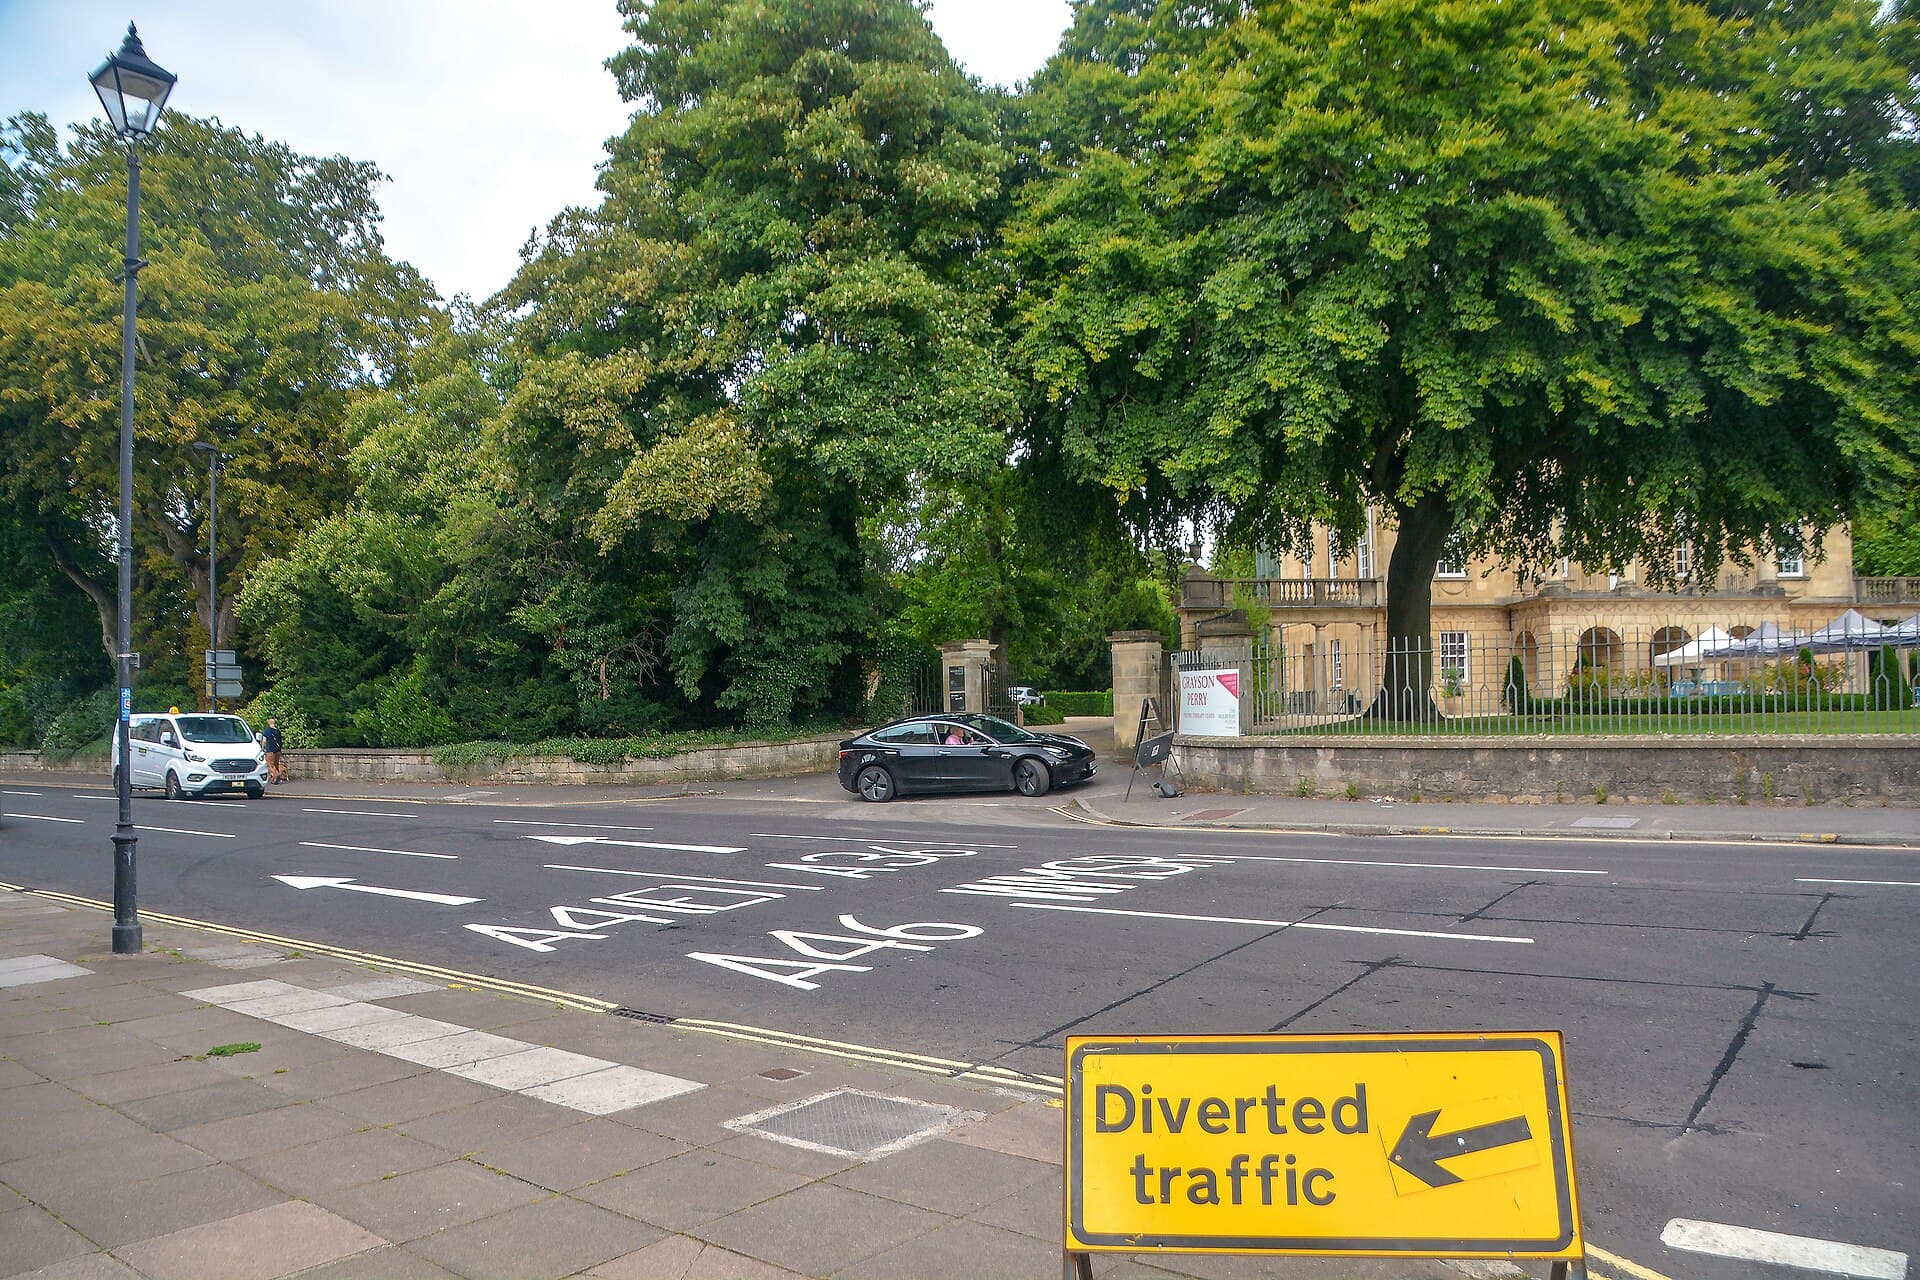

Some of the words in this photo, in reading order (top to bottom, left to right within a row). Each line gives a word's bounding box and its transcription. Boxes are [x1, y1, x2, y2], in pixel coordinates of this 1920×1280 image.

[1182, 675, 1215, 689] GRAYSON
[1187, 692, 1208, 706] PERRY
[764, 845, 979, 879] A36
[685, 914, 985, 990] A46
[1095, 1083, 1369, 1134] Diverted
[1130, 1152, 1336, 1206] traffic
